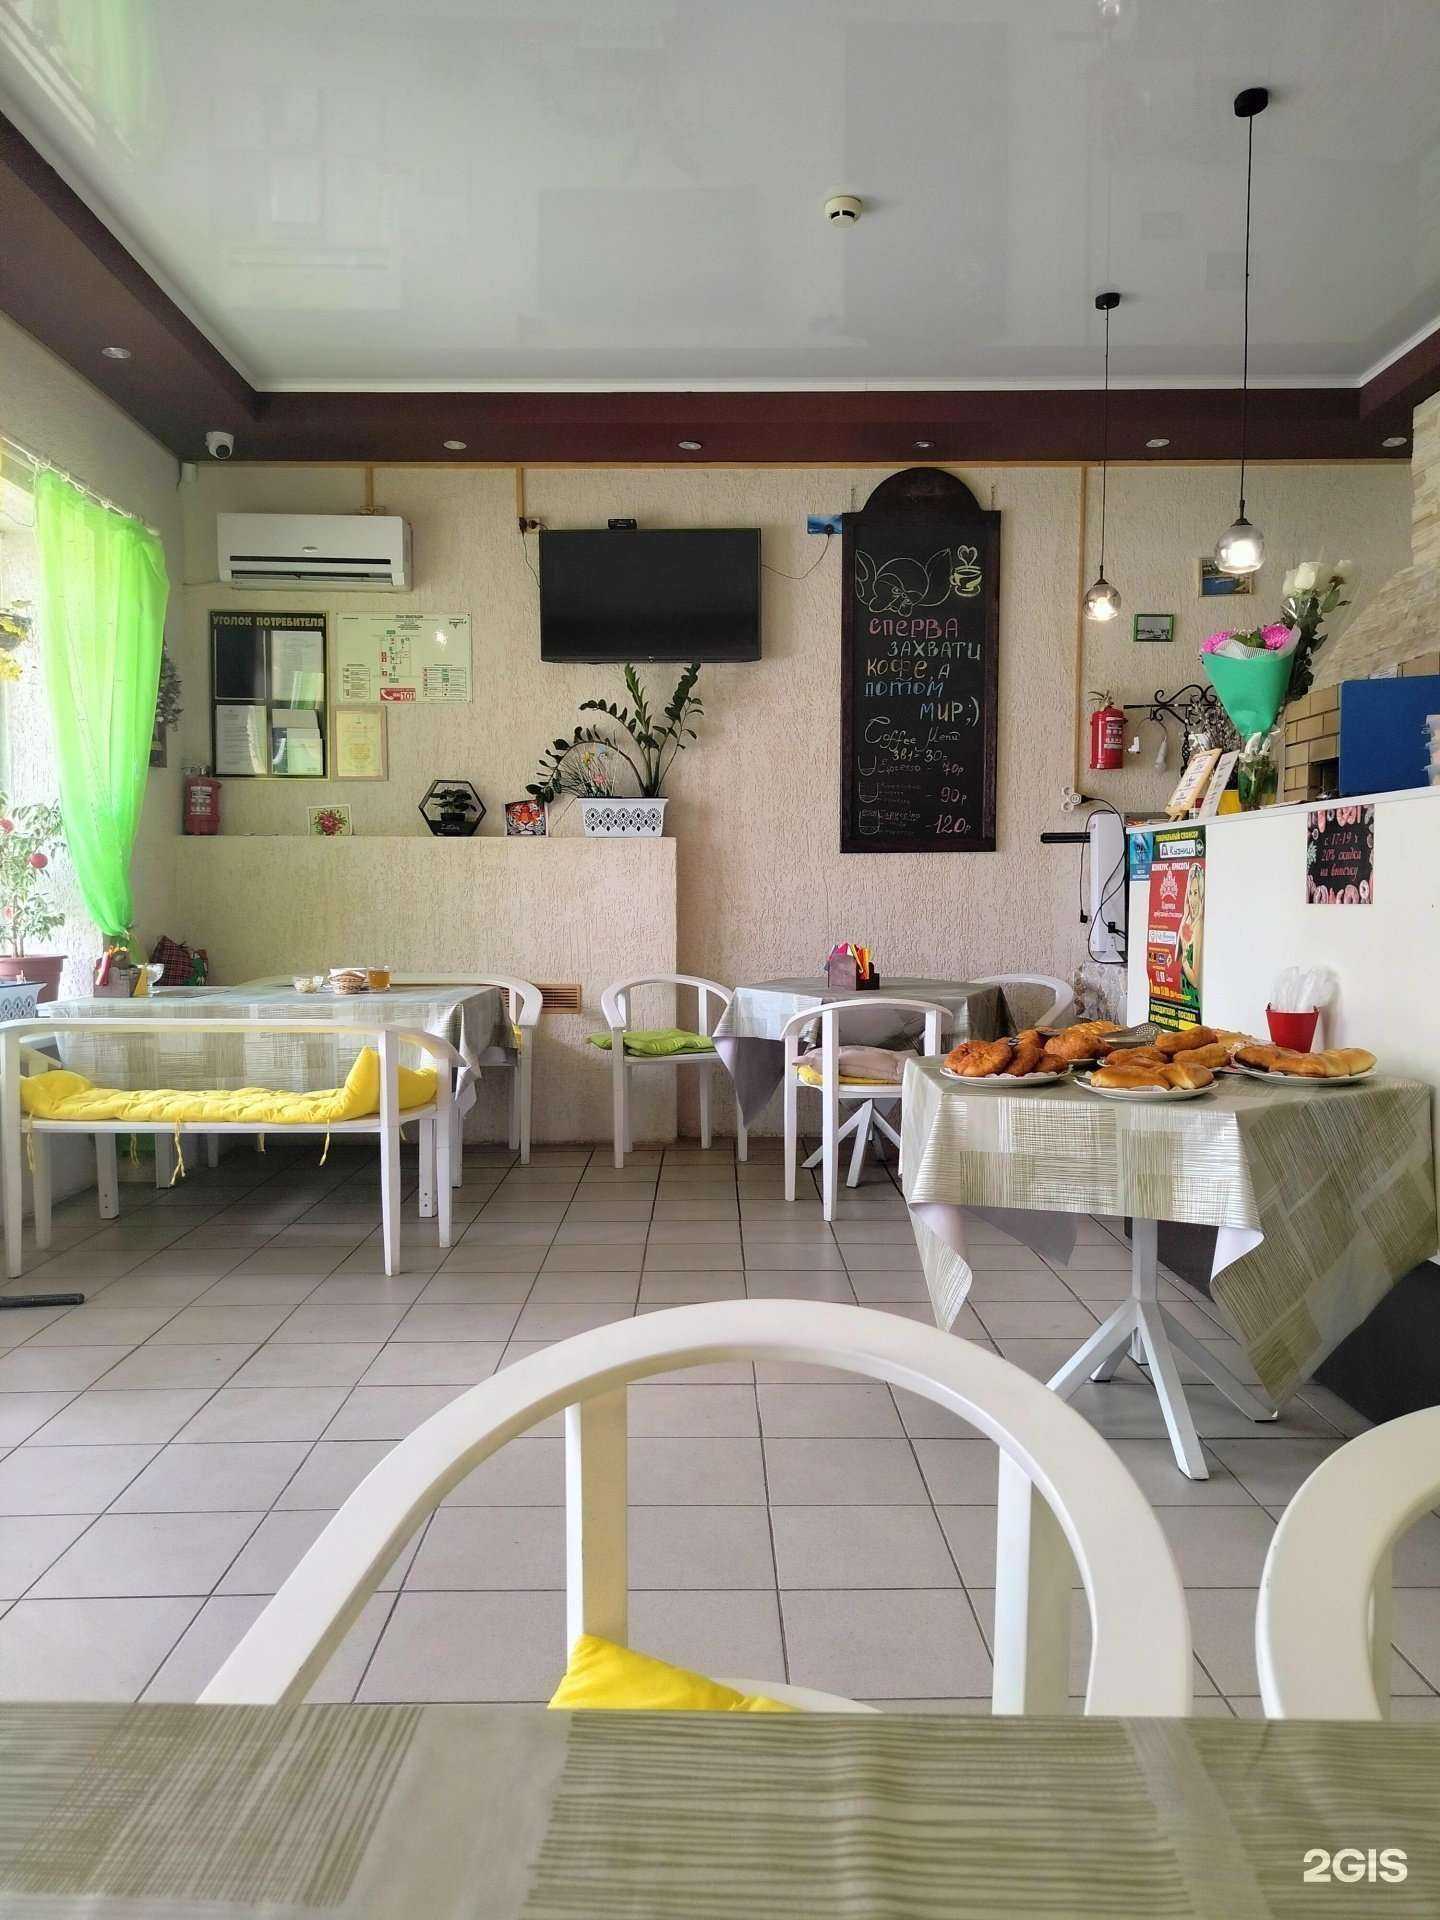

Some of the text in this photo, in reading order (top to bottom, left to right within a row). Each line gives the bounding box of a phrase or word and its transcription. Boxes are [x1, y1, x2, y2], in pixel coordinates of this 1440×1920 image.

[212, 615, 324, 627] УГОЛОК ПОТРЕБИТЕЛЯ
[887, 640, 981, 660] ЗАХВАТИ
